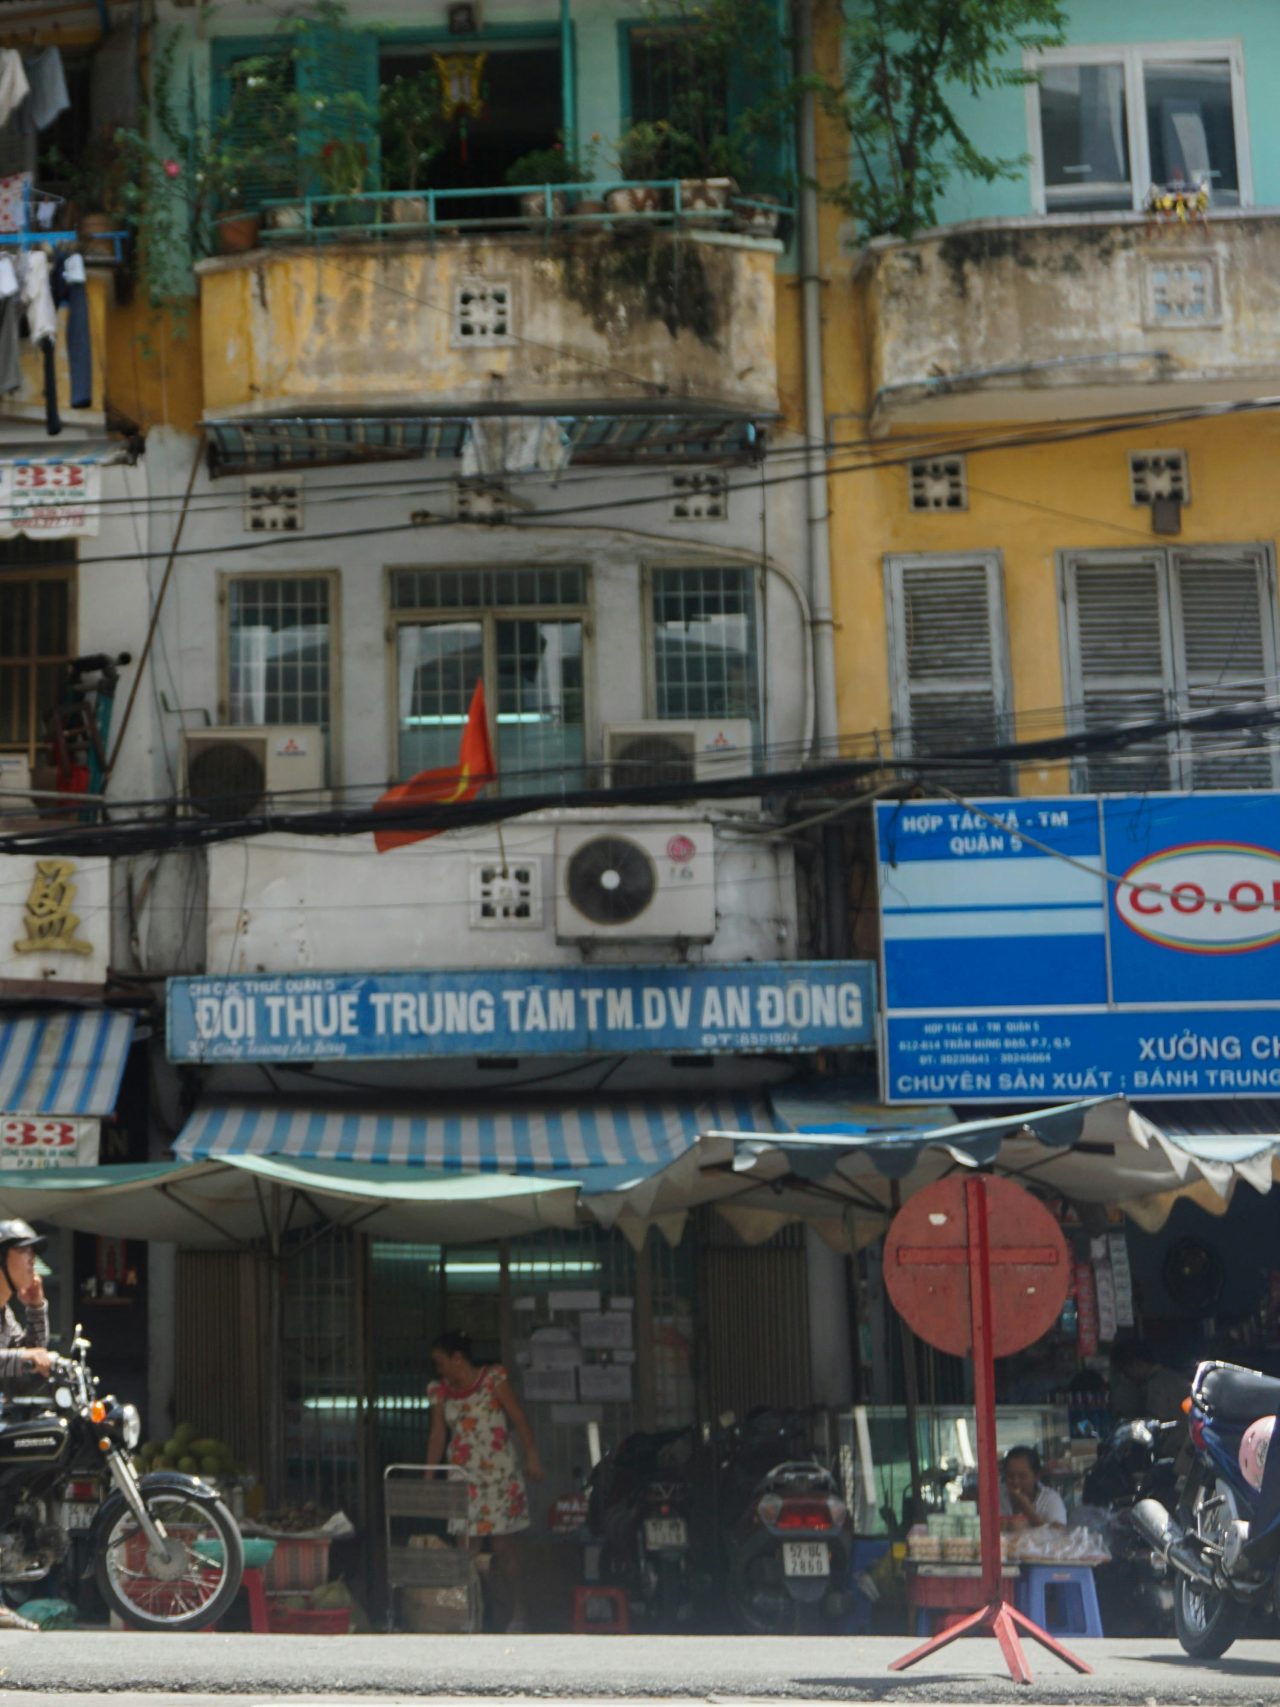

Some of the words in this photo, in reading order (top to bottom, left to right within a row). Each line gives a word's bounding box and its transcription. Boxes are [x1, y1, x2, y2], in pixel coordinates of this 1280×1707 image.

[16, 464, 84, 488] 33
[902, 812, 944, 834] HỢP
[1038, 810, 1069, 828] TM
[949, 833, 1005, 856] QUẬN
[1010, 834, 1024, 852] 5
[370, 990, 495, 1036] TRUNG
[701, 986, 751, 1029] AN
[1138, 1029, 1242, 1061] XƯỞNG
[896, 1070, 992, 1094] CHUYÊN
[998, 1067, 1045, 1091] SẢN
[1052, 1065, 1113, 1090] XUẤT
[1133, 1066, 1199, 1088] BÁNH
[3, 1120, 76, 1146] 33
